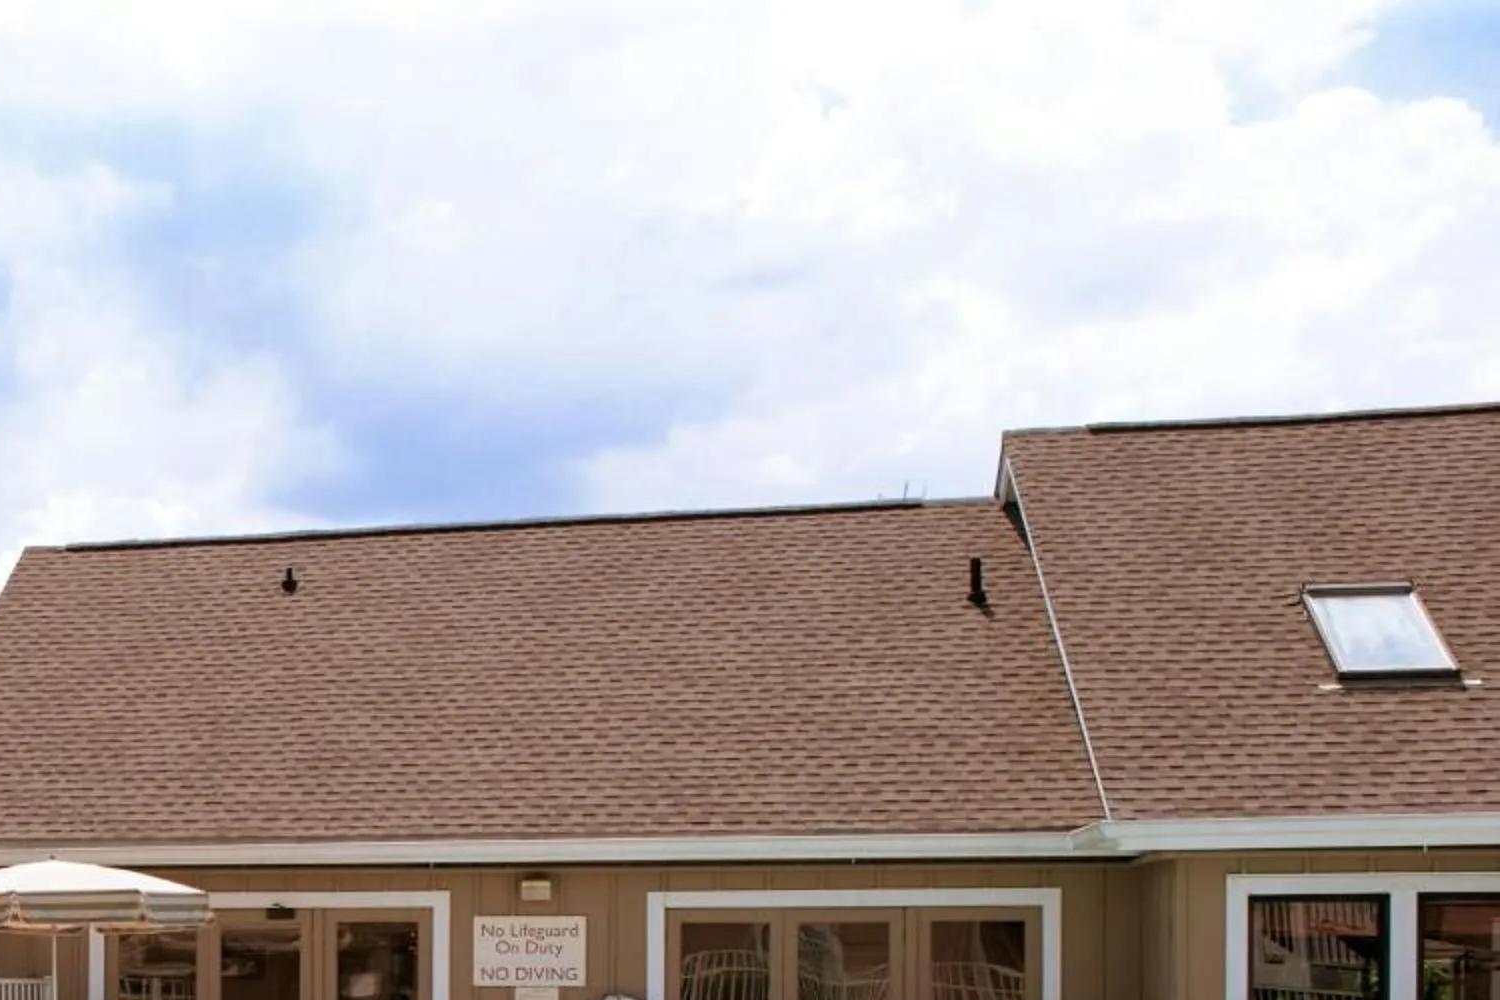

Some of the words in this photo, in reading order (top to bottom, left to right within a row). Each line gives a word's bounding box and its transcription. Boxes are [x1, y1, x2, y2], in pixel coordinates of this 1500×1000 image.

[481, 924, 505, 937] No
[512, 922, 579, 941] Lifeguard
[495, 940, 519, 954] On
[526, 940, 563, 958] Duty
[481, 967, 509, 981] NO
[516, 967, 578, 981] DIVING
